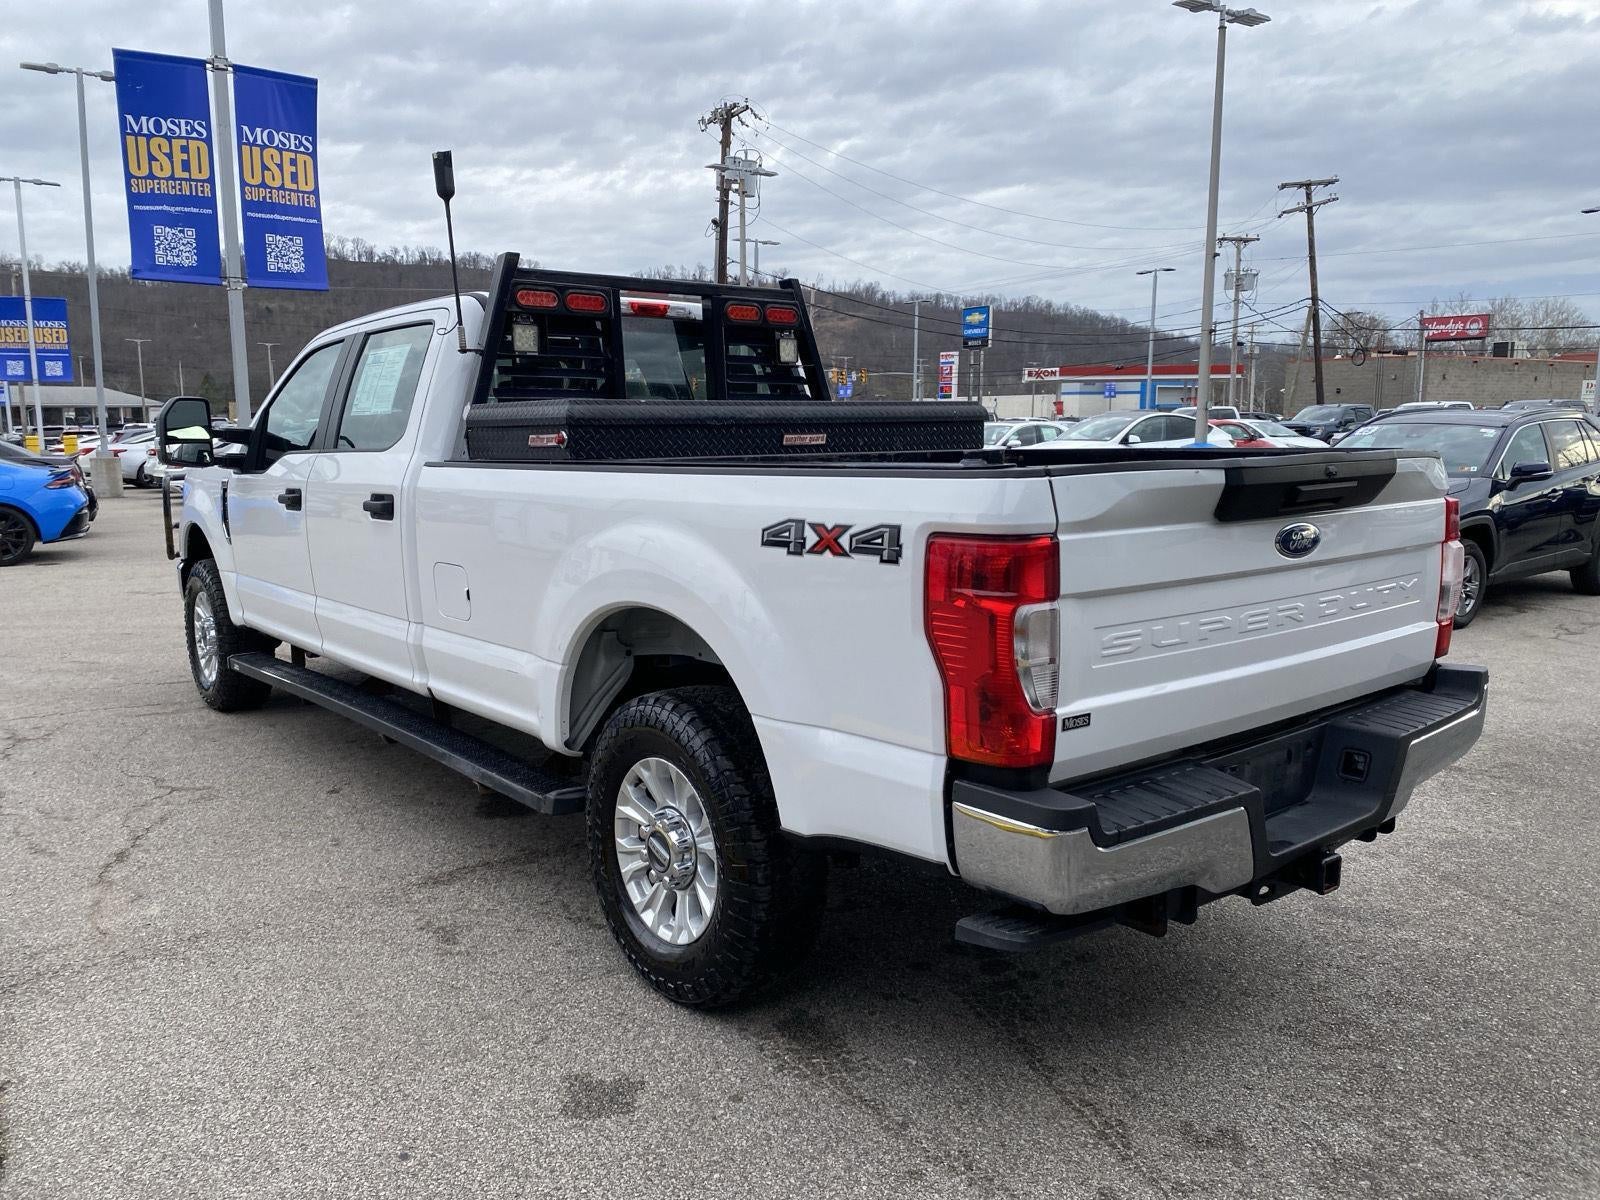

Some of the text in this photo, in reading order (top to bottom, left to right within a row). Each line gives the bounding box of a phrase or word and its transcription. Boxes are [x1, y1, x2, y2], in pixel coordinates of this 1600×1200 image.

[124, 114, 207, 139] MOSES
[241, 125, 313, 153] MOSES
[126, 135, 210, 180] USED
[241, 145, 315, 192] USED
[131, 179, 212, 197] SUPERCENTER
[245, 186, 316, 208] SUPERCENTER
[133, 204, 213, 215] mosesusedsupercenter.com
[34, 320, 67, 328] MOSES
[1424, 318, 1464, 338] Wendy's
[34, 328, 68, 344] USED
[1028, 368, 1057, 379] EXXON
[1100, 578, 1420, 658] SUPER DUTY
[1064, 716, 1089, 729] MOSES
